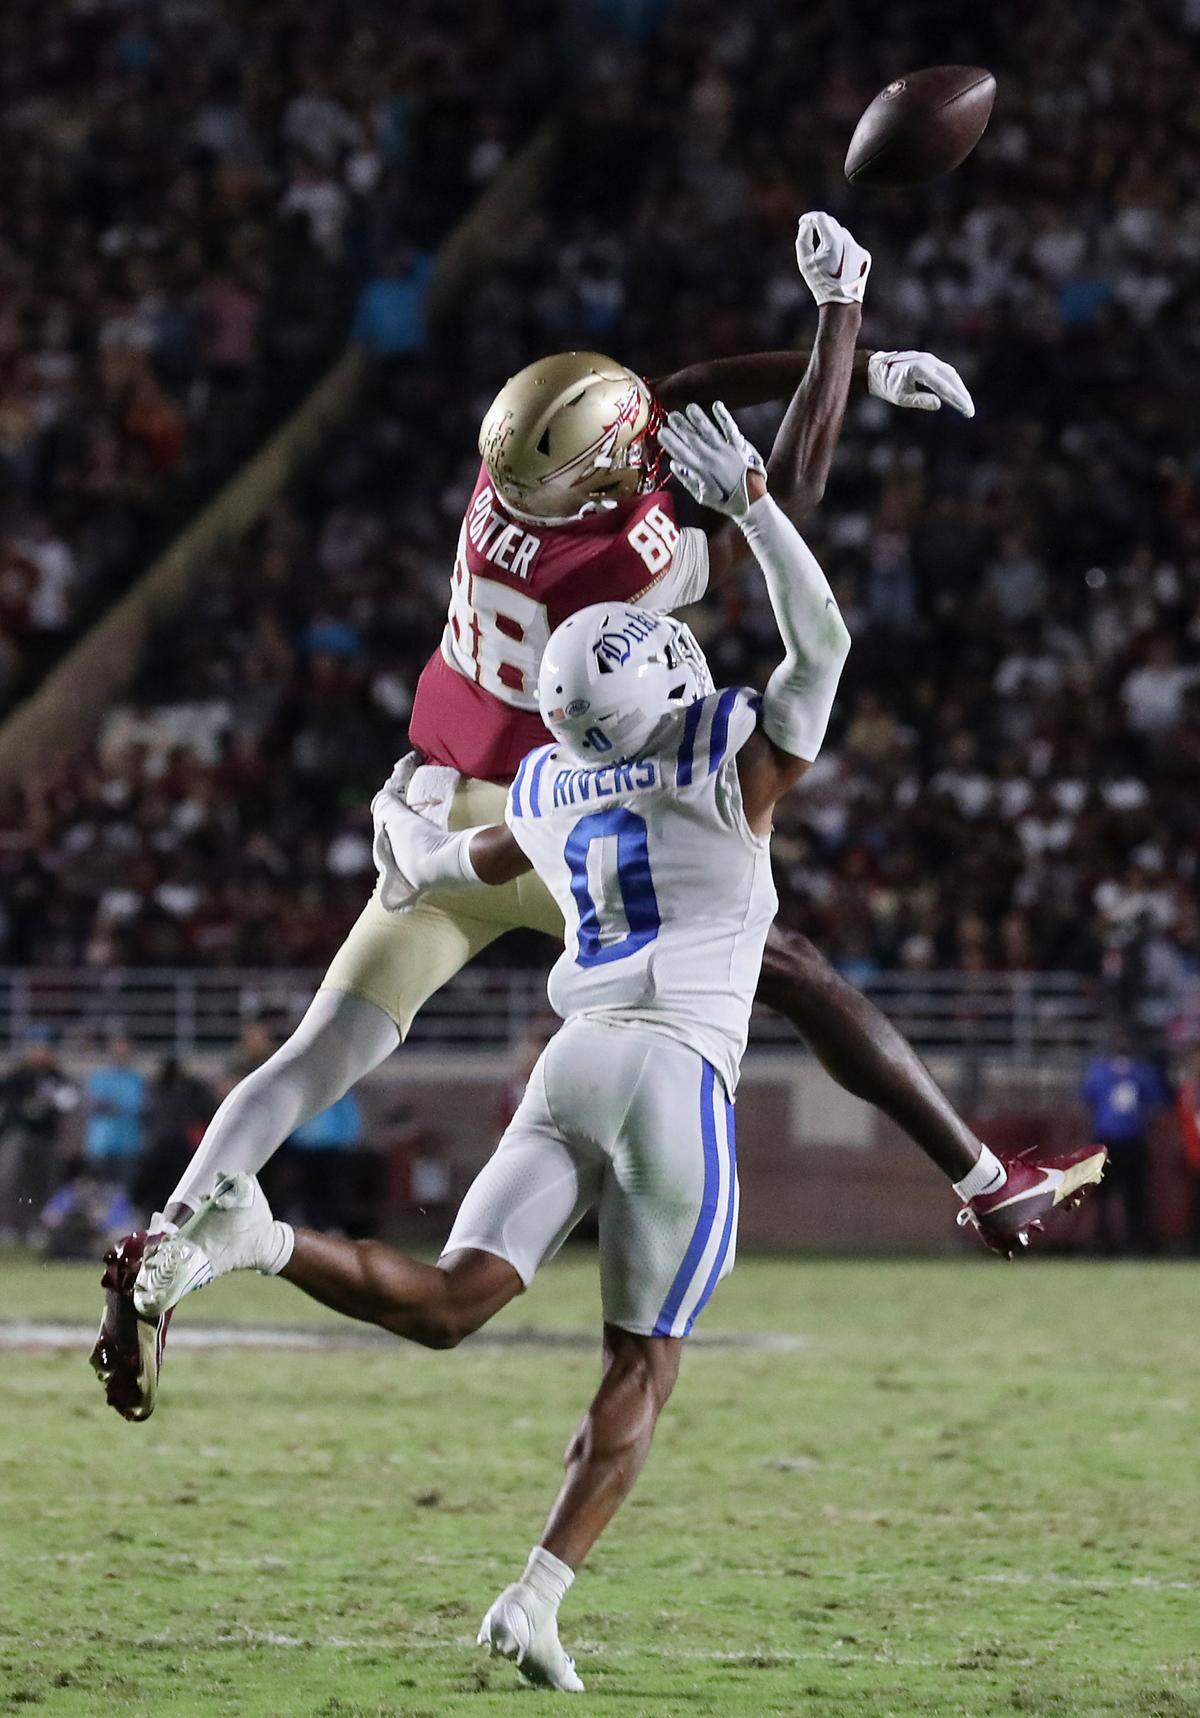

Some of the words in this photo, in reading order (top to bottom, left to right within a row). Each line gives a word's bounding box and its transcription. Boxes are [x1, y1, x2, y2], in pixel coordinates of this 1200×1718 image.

[627, 504, 680, 575] 88
[441, 515, 552, 712] 88
[553, 759, 656, 808] RIVERS
[564, 806, 661, 968] 0
